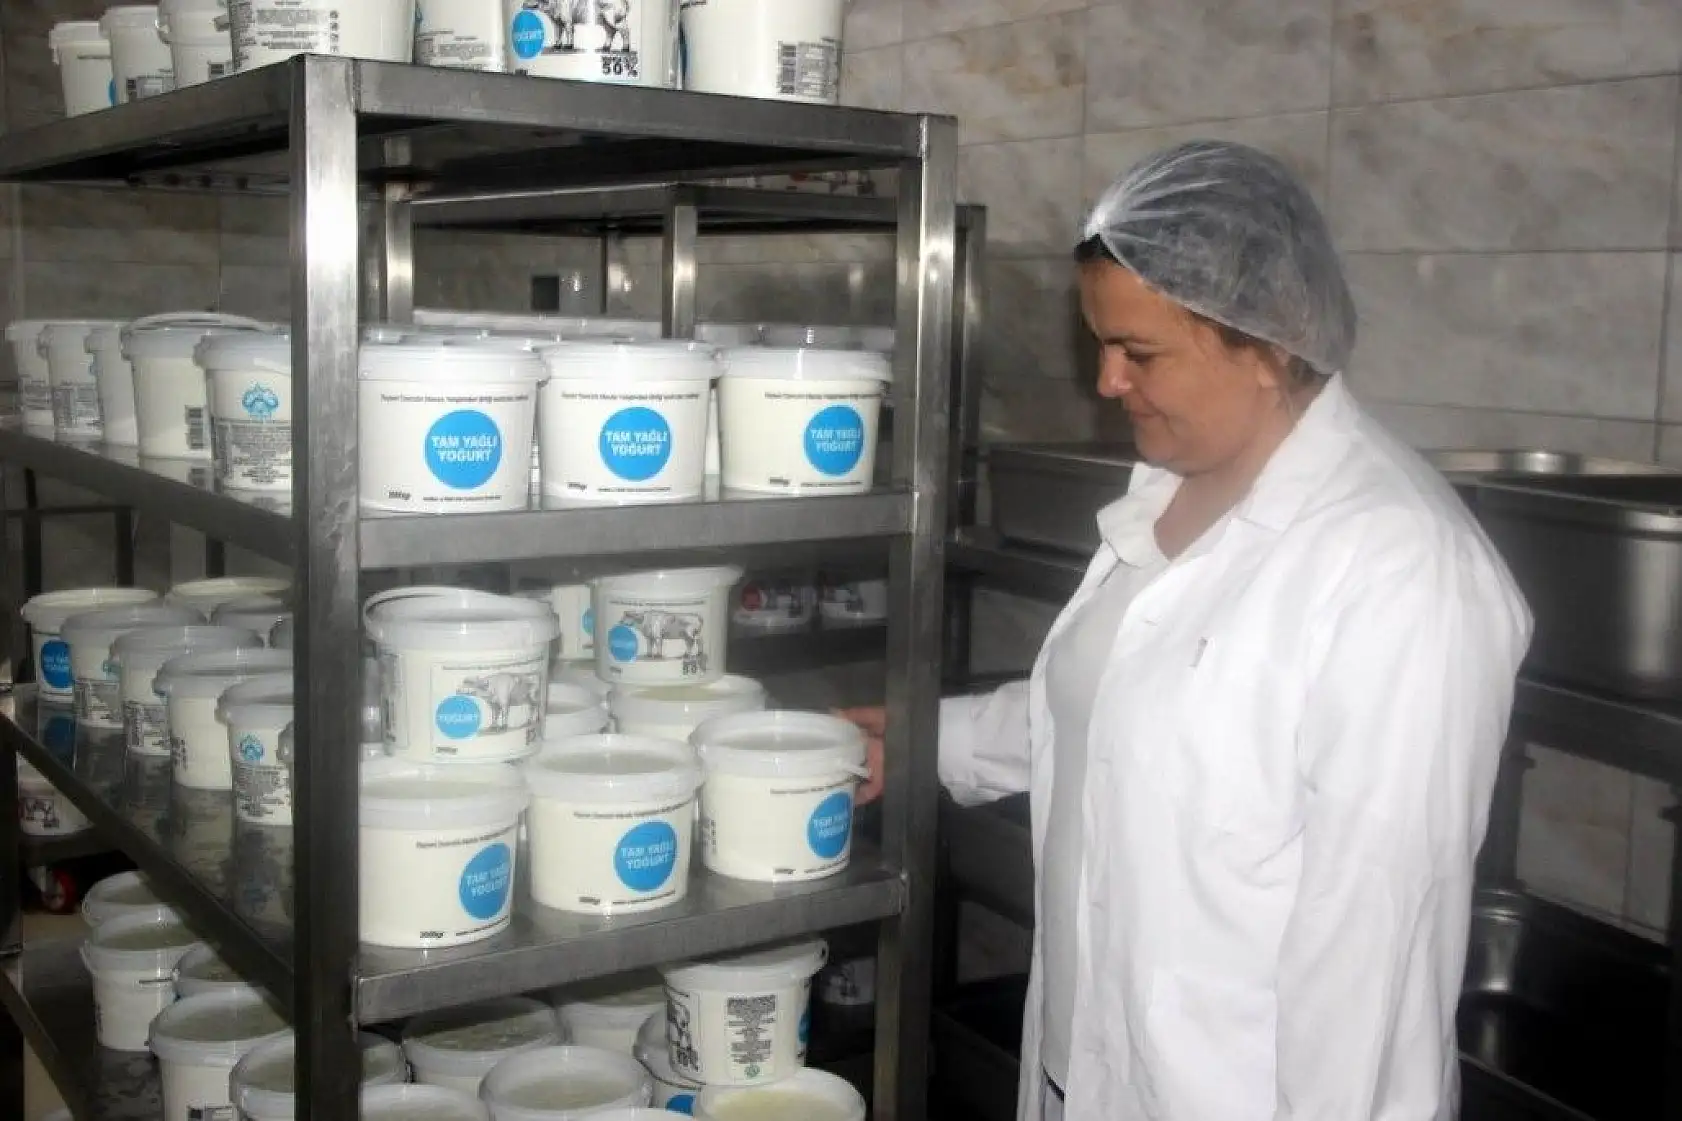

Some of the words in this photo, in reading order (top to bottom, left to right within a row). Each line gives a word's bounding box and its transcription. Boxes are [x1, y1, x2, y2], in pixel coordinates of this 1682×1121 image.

[601, 58, 639, 78] 50%
[605, 430, 631, 443] TAM
[810, 427, 833, 439] TAM
[431, 435, 460, 449] TAM
[620, 845, 645, 858] TAM
